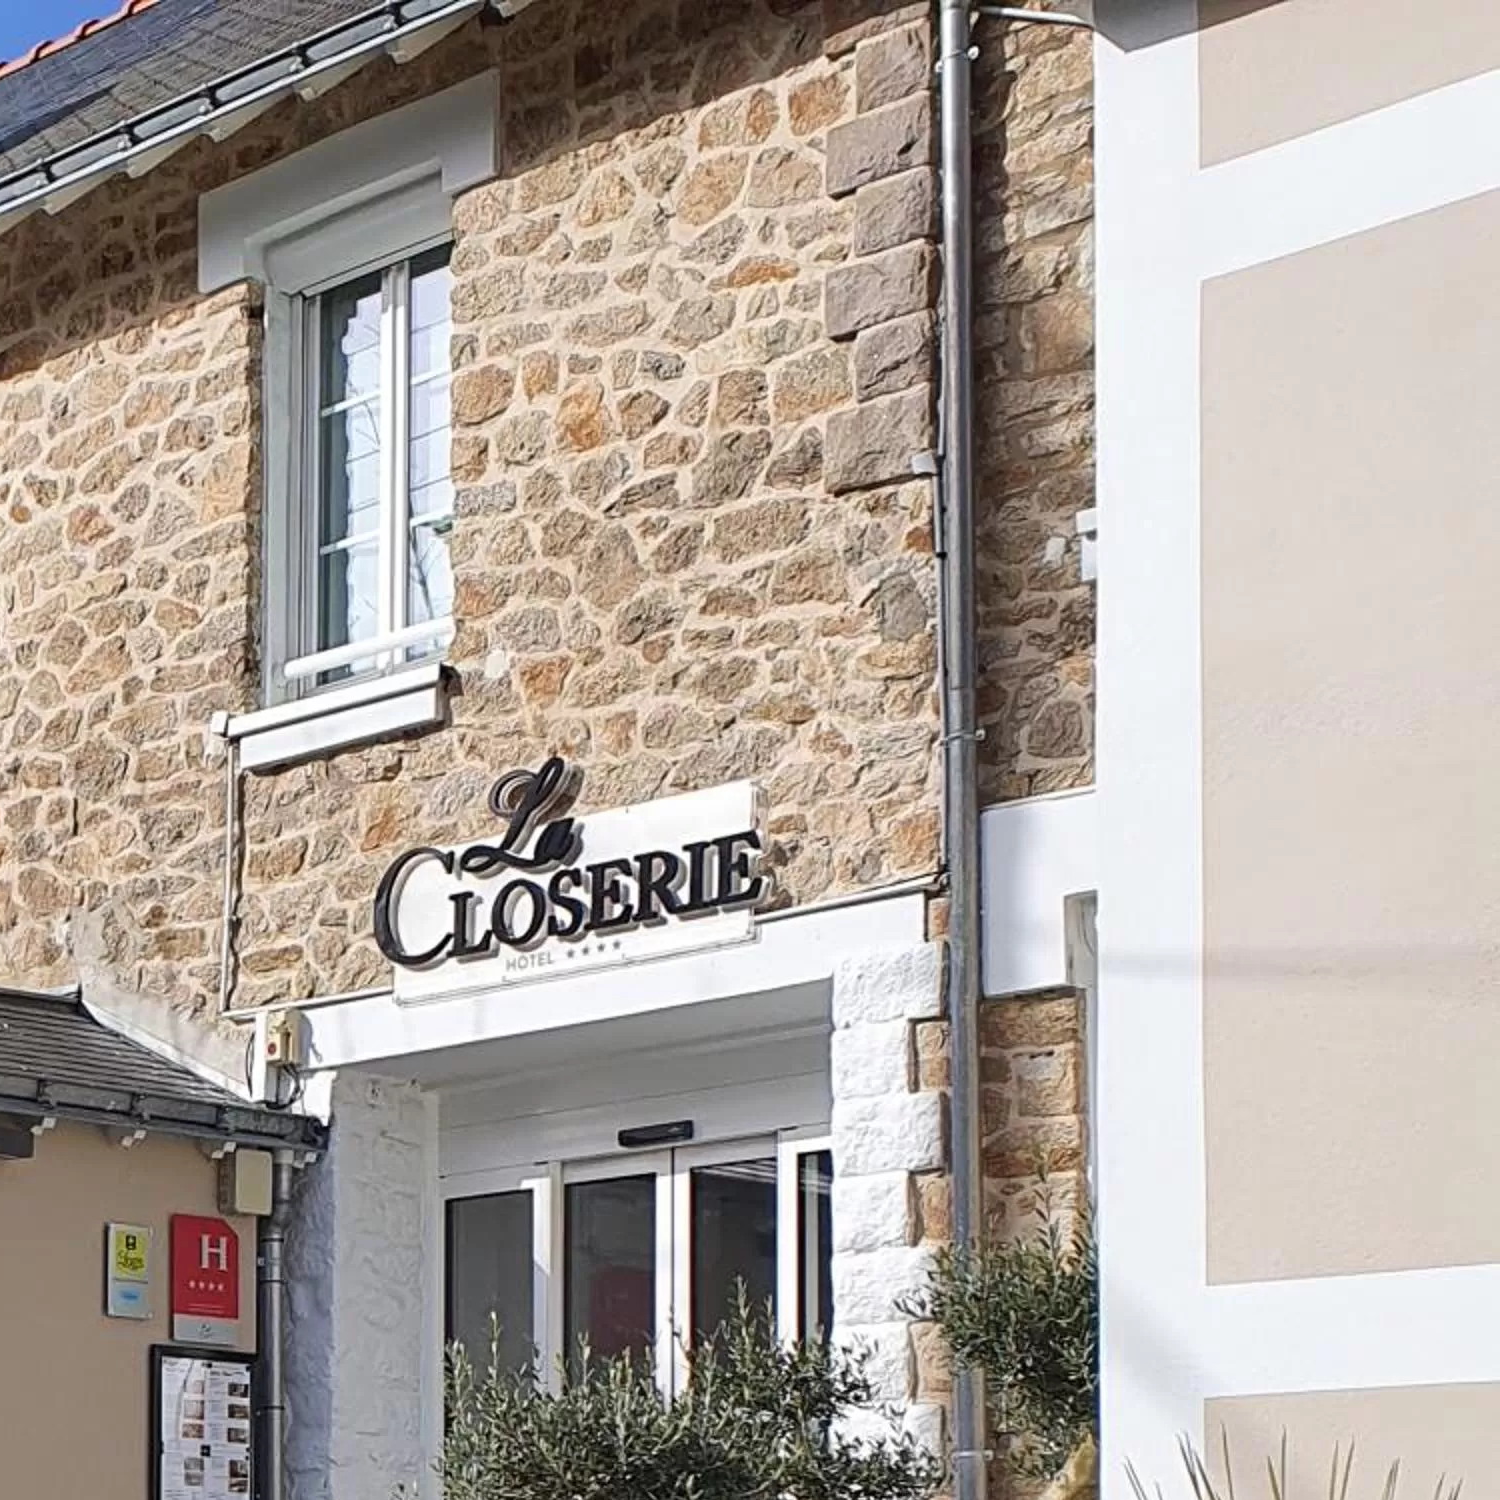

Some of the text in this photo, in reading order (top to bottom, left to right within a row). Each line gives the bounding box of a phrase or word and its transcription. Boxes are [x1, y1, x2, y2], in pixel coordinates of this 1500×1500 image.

[460, 757, 575, 873] La
[374, 829, 764, 967] CLOSERIE
[201, 1234, 228, 1272] H
